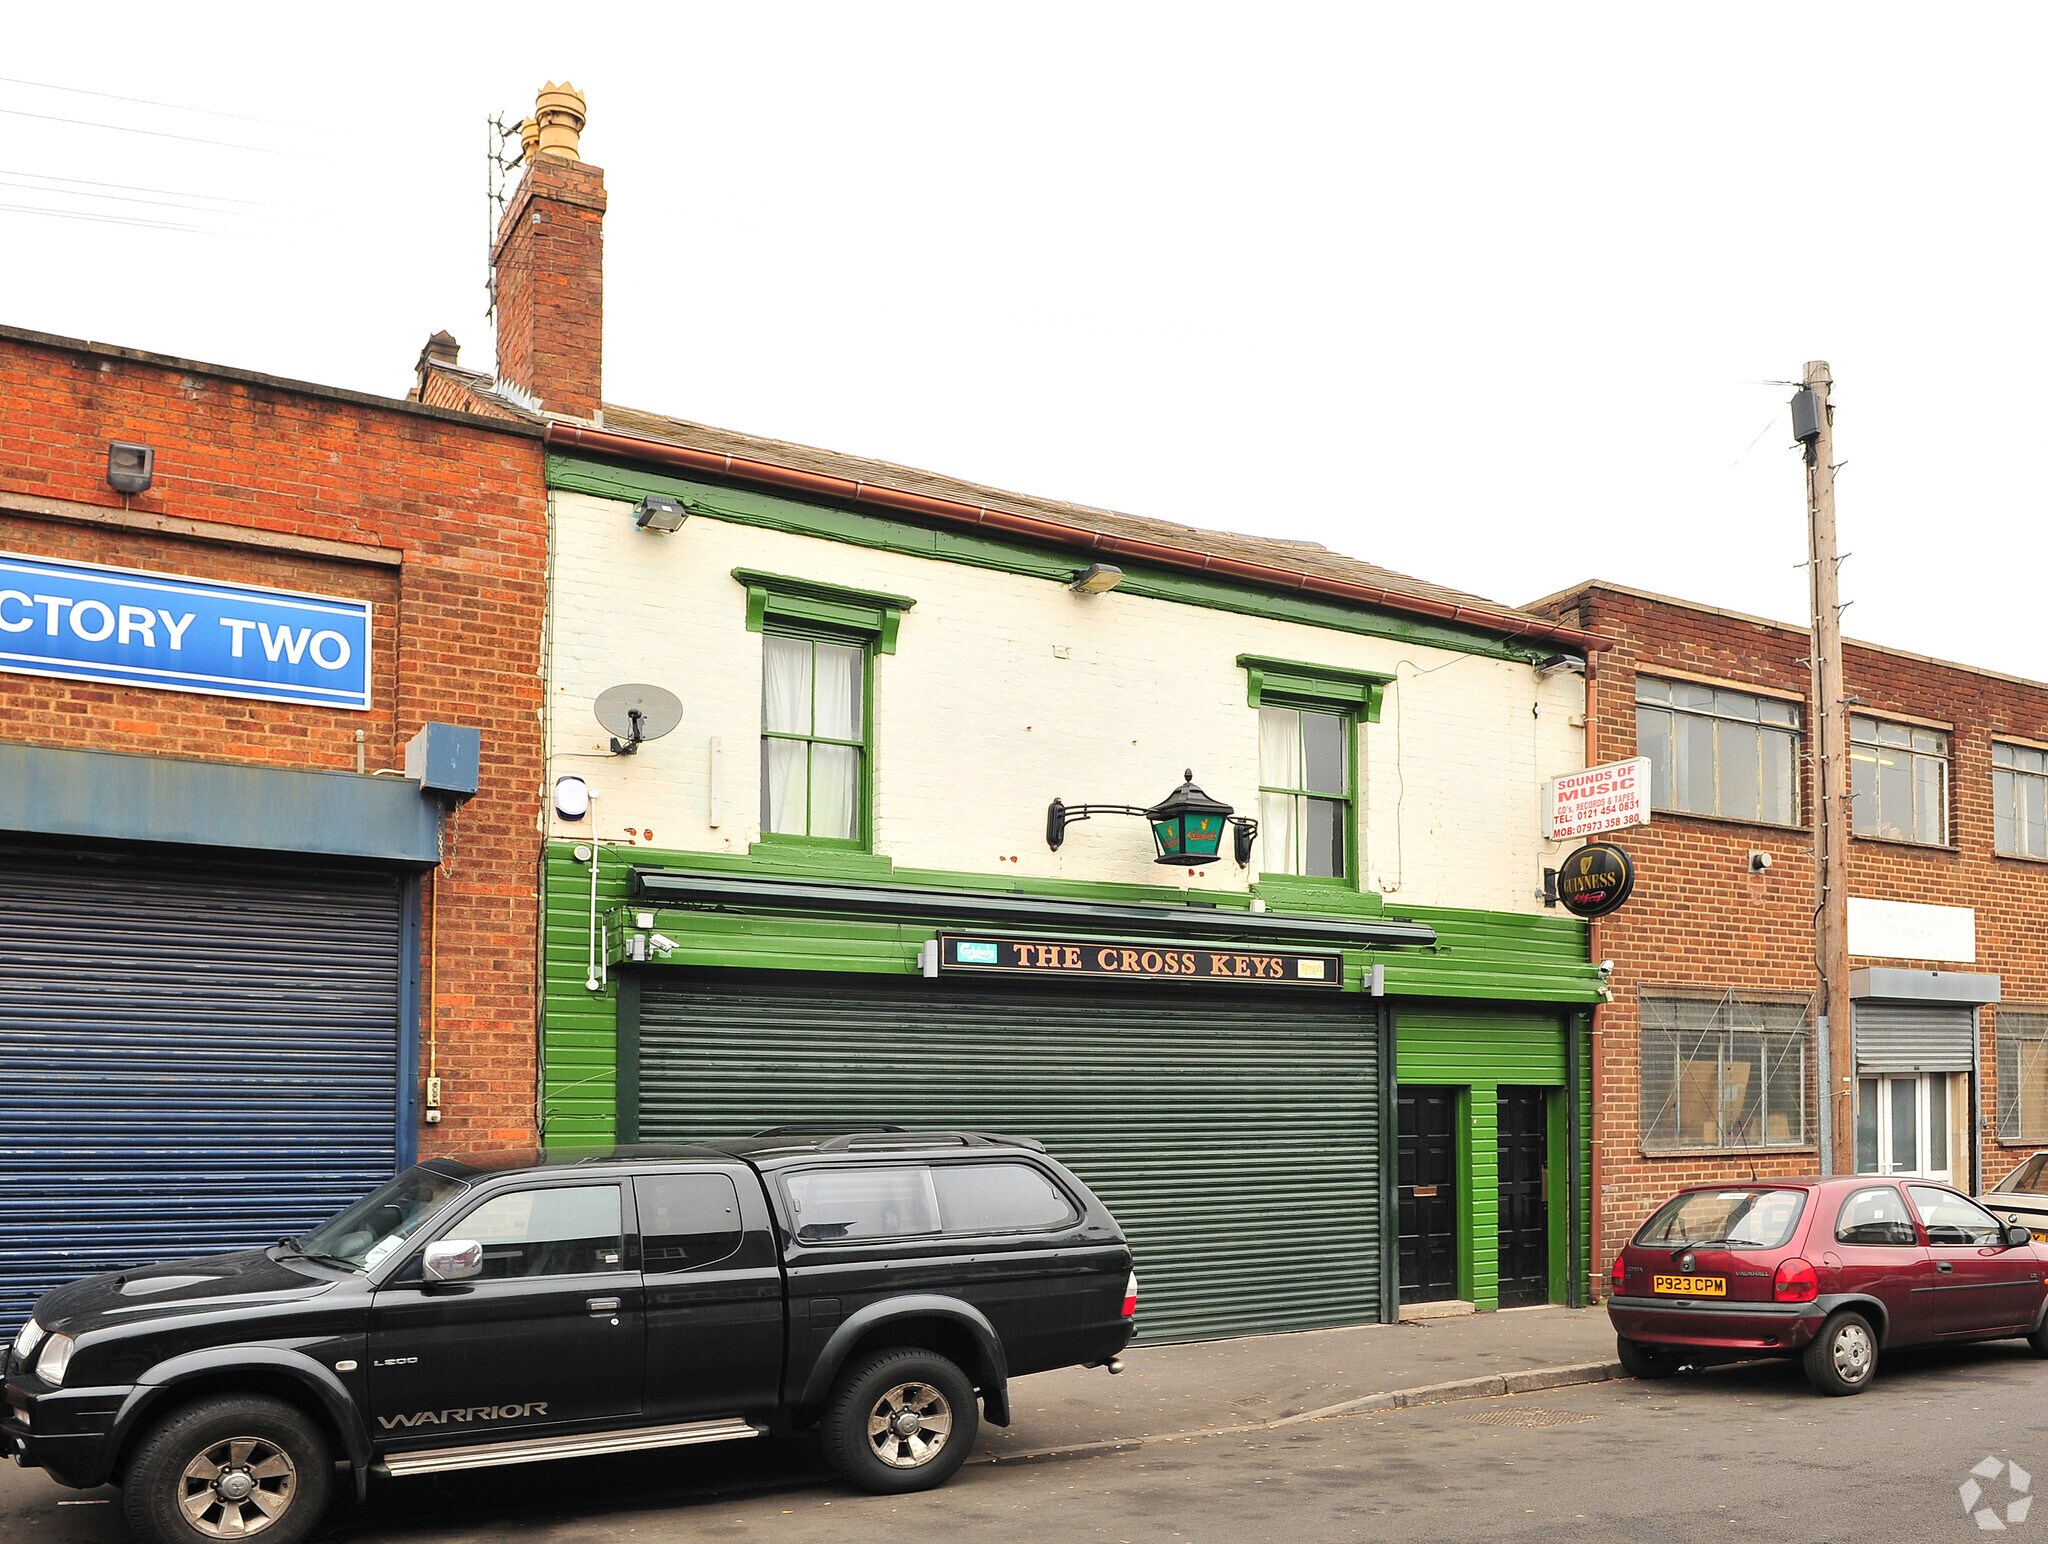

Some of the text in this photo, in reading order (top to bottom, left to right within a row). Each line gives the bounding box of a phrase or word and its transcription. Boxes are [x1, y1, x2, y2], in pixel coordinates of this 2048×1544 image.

[0, 589, 352, 671] CTORY TWO
[1558, 765, 1635, 790] SOUNDS OF
[1558, 777, 1635, 803] MUSIC
[1553, 799, 1639, 824] TEL: 0121 454 0831
[1576, 798, 1605, 811] RECORDS
[1614, 792, 1635, 803] TAPES
[1604, 817, 1620, 828] 358
[1623, 813, 1640, 825] 380
[1013, 943, 1284, 978] THE CROSS KEYS
[1656, 1277, 1723, 1292] P923 CPM
[377, 1401, 548, 1430] WARRIOR
